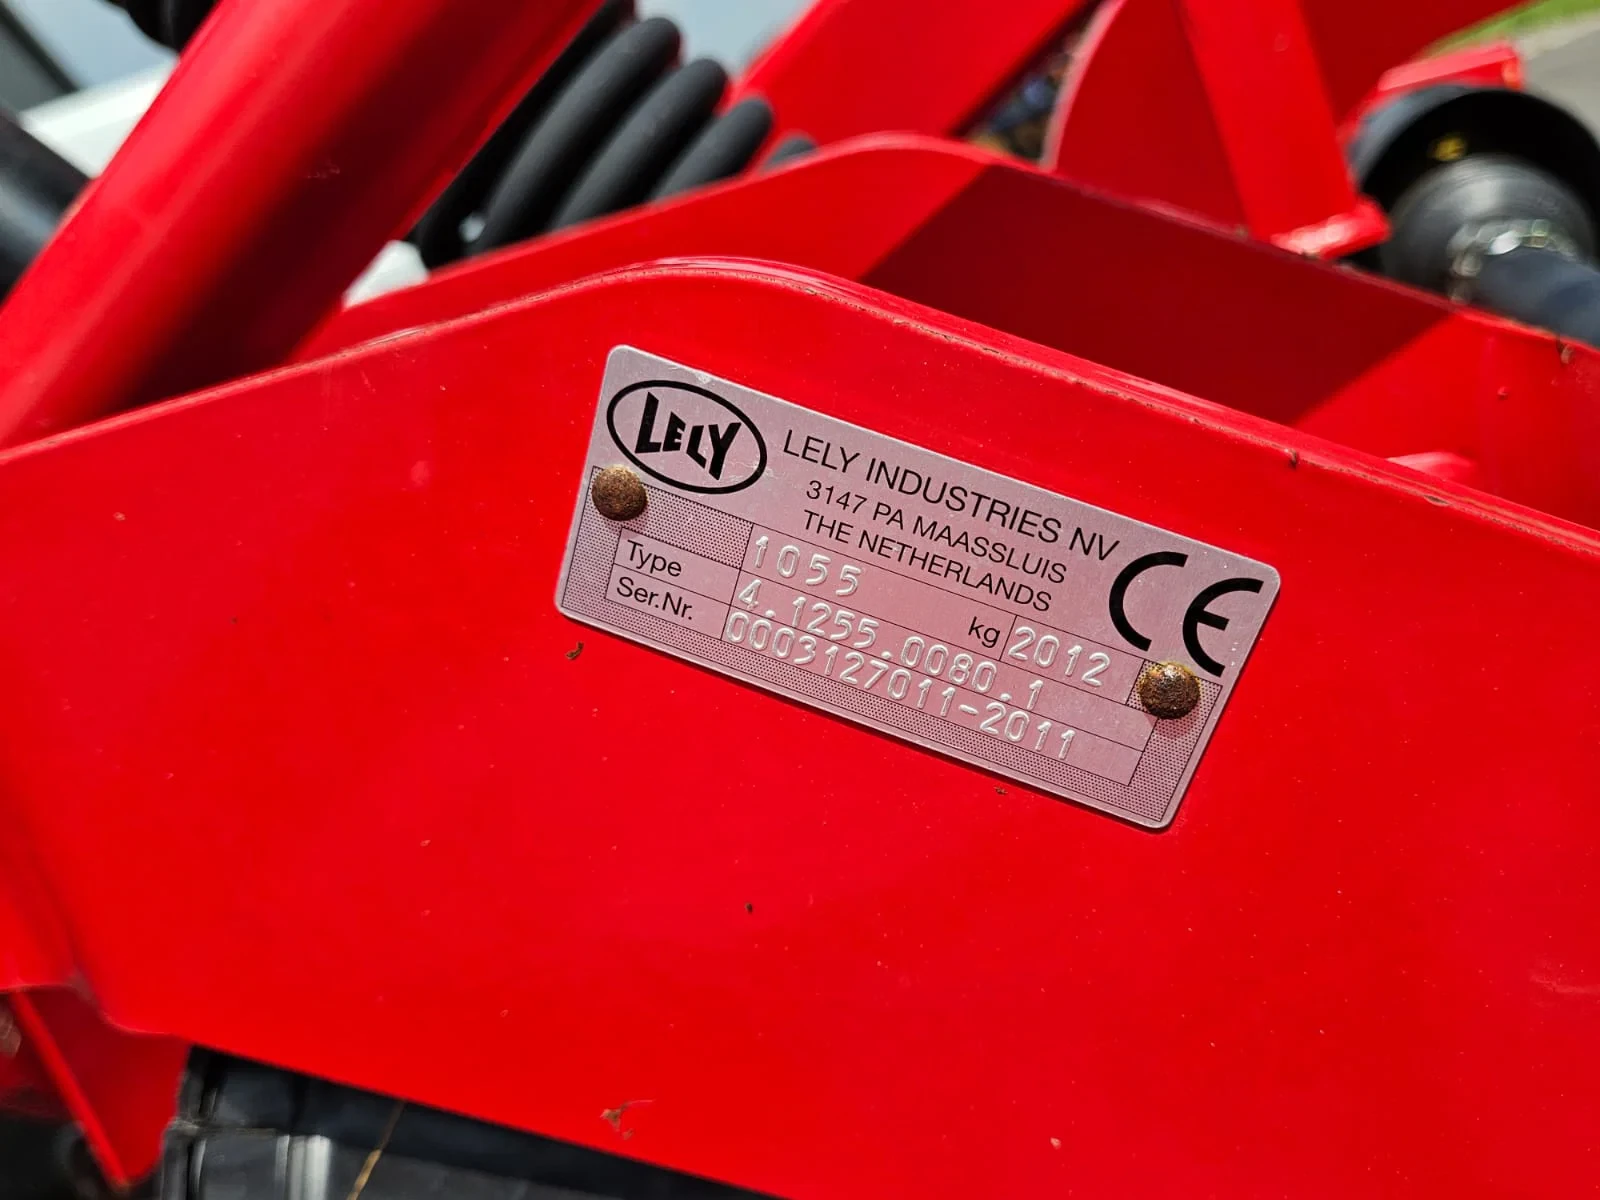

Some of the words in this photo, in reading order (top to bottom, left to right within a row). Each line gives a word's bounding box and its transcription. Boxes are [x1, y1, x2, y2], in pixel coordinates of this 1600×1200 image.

[635, 392, 741, 480] LELY
[783, 429, 860, 473] LELY
[866, 458, 1061, 543] INDUSTRIES
[1069, 527, 1120, 561] NV
[803, 509, 854, 544] THE
[859, 530, 1052, 612] NETHERLANDS
[806, 480, 867, 514] 3147
[873, 502, 904, 530] PA
[913, 516, 1067, 584] MAASSLUIS
[616, 577, 693, 620] Ser.Nr.
[726, 611, 1075, 759] 0003127011-2011
[626, 540, 682, 577] Type
[738, 579, 1043, 710] 4.1255.0080.1
[755, 535, 861, 596] 1055
[968, 616, 1001, 648] kg
[1008, 626, 1110, 686] 2012
[1109, 551, 1264, 678] CE
